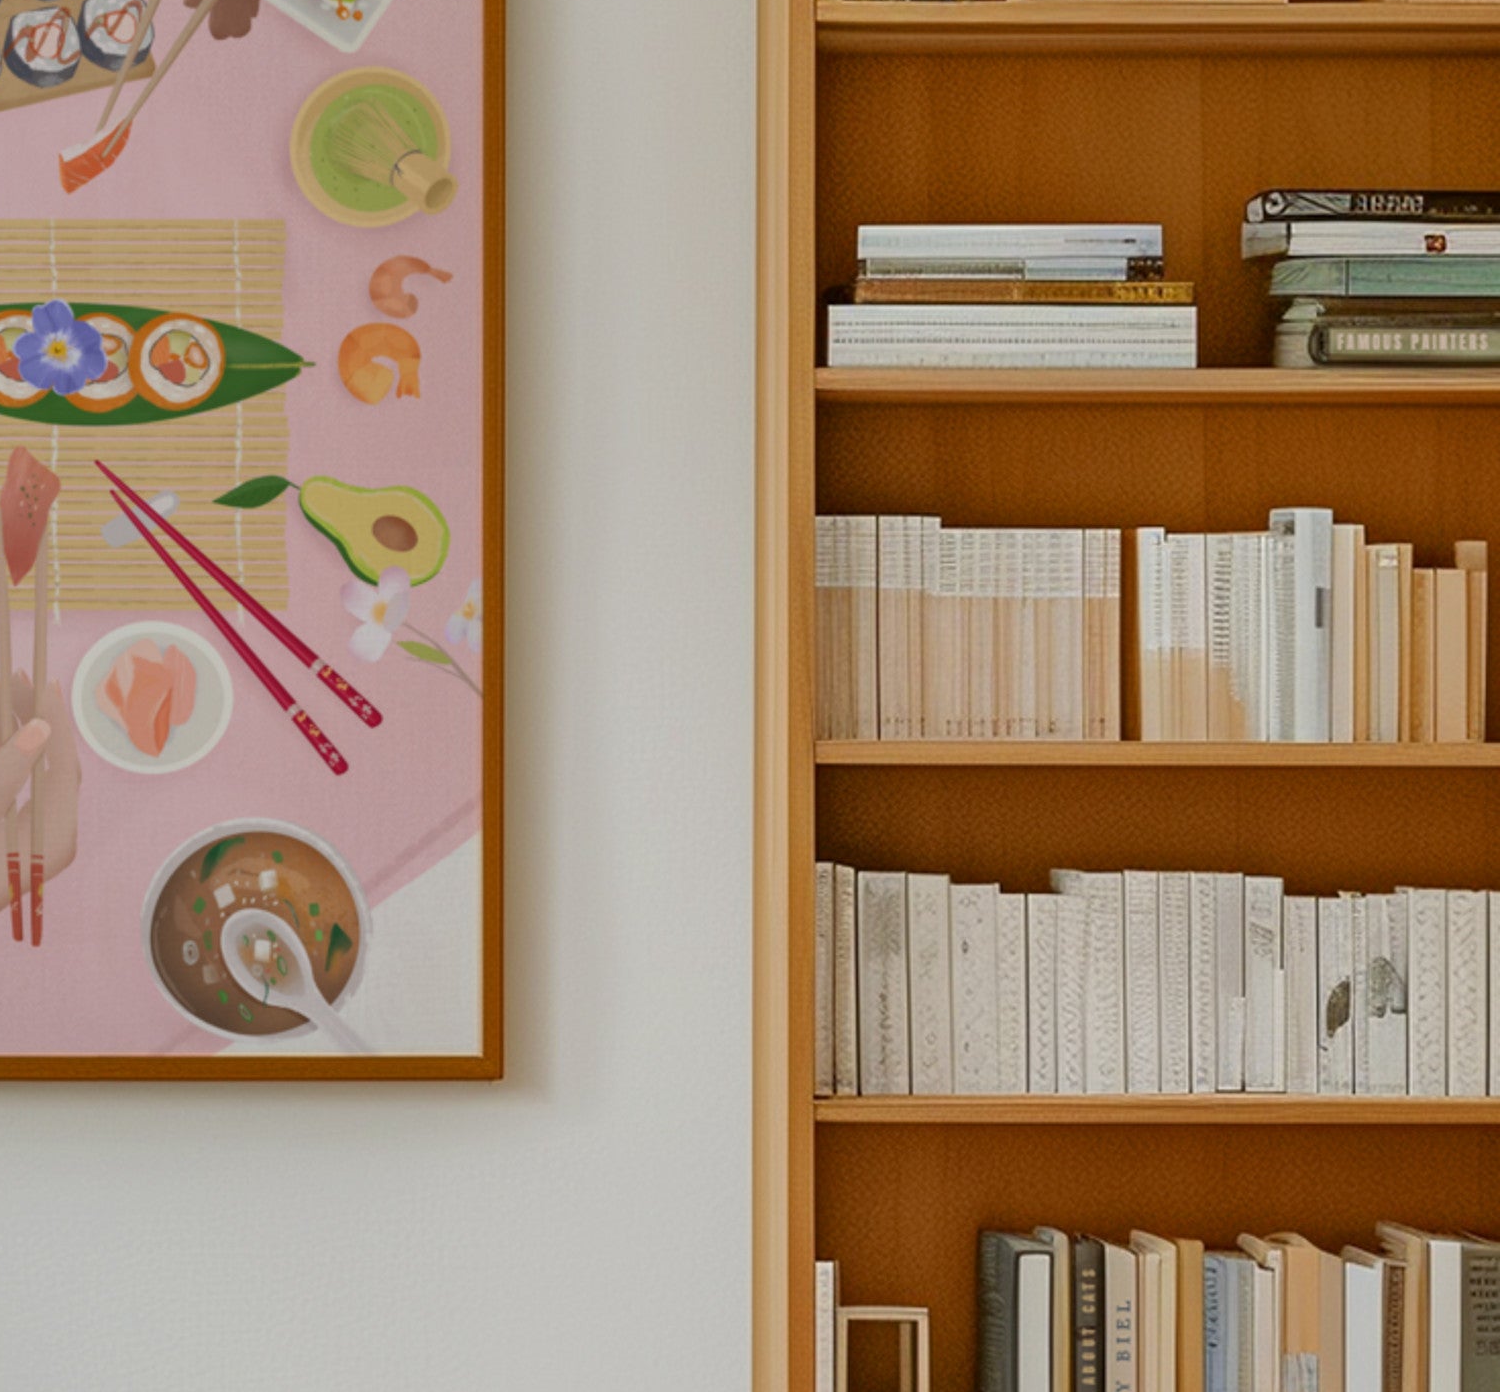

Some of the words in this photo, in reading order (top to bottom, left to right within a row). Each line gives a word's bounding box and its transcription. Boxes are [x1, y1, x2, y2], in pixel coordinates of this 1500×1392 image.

[1336, 332, 1402, 351] FAMOUS
[1410, 332, 1489, 351] PAINTERS
[1081, 1268, 1097, 1314] CATS
[1081, 1327, 1096, 1386] ABOUT
[1116, 1300, 1132, 1362] BIEL
